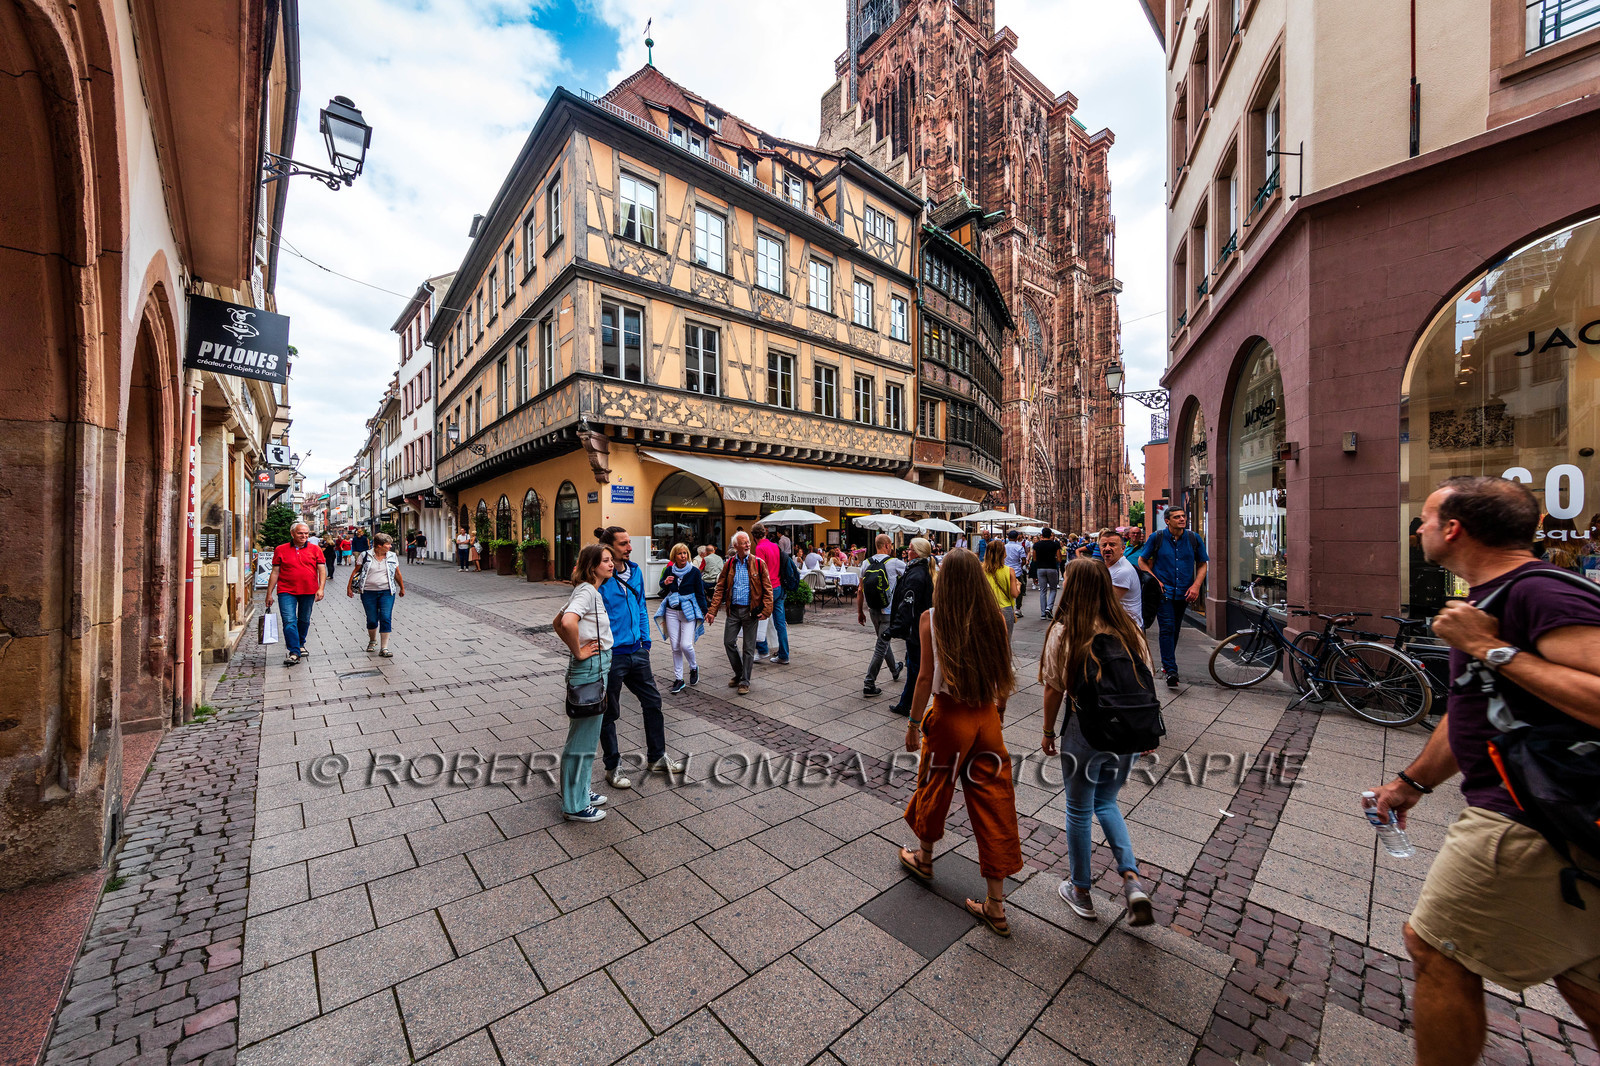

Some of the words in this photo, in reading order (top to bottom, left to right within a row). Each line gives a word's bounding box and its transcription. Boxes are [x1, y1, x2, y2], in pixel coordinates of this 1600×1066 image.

[197, 358, 226, 367] créateur
[227, 364, 254, 374] d'objets
[261, 370, 277, 378] Paris
[198, 340, 279, 370] PYLONES
[762, 491, 789, 503] Maison
[790, 493, 828, 506] Kammerzell
[838, 496, 864, 507] HOTEL
[866, 498, 872, 507] &
[875, 499, 918, 510] RESTAURANT
[1242, 487, 1278, 527] SOLDES
[1501, 464, 1585, 520] O
